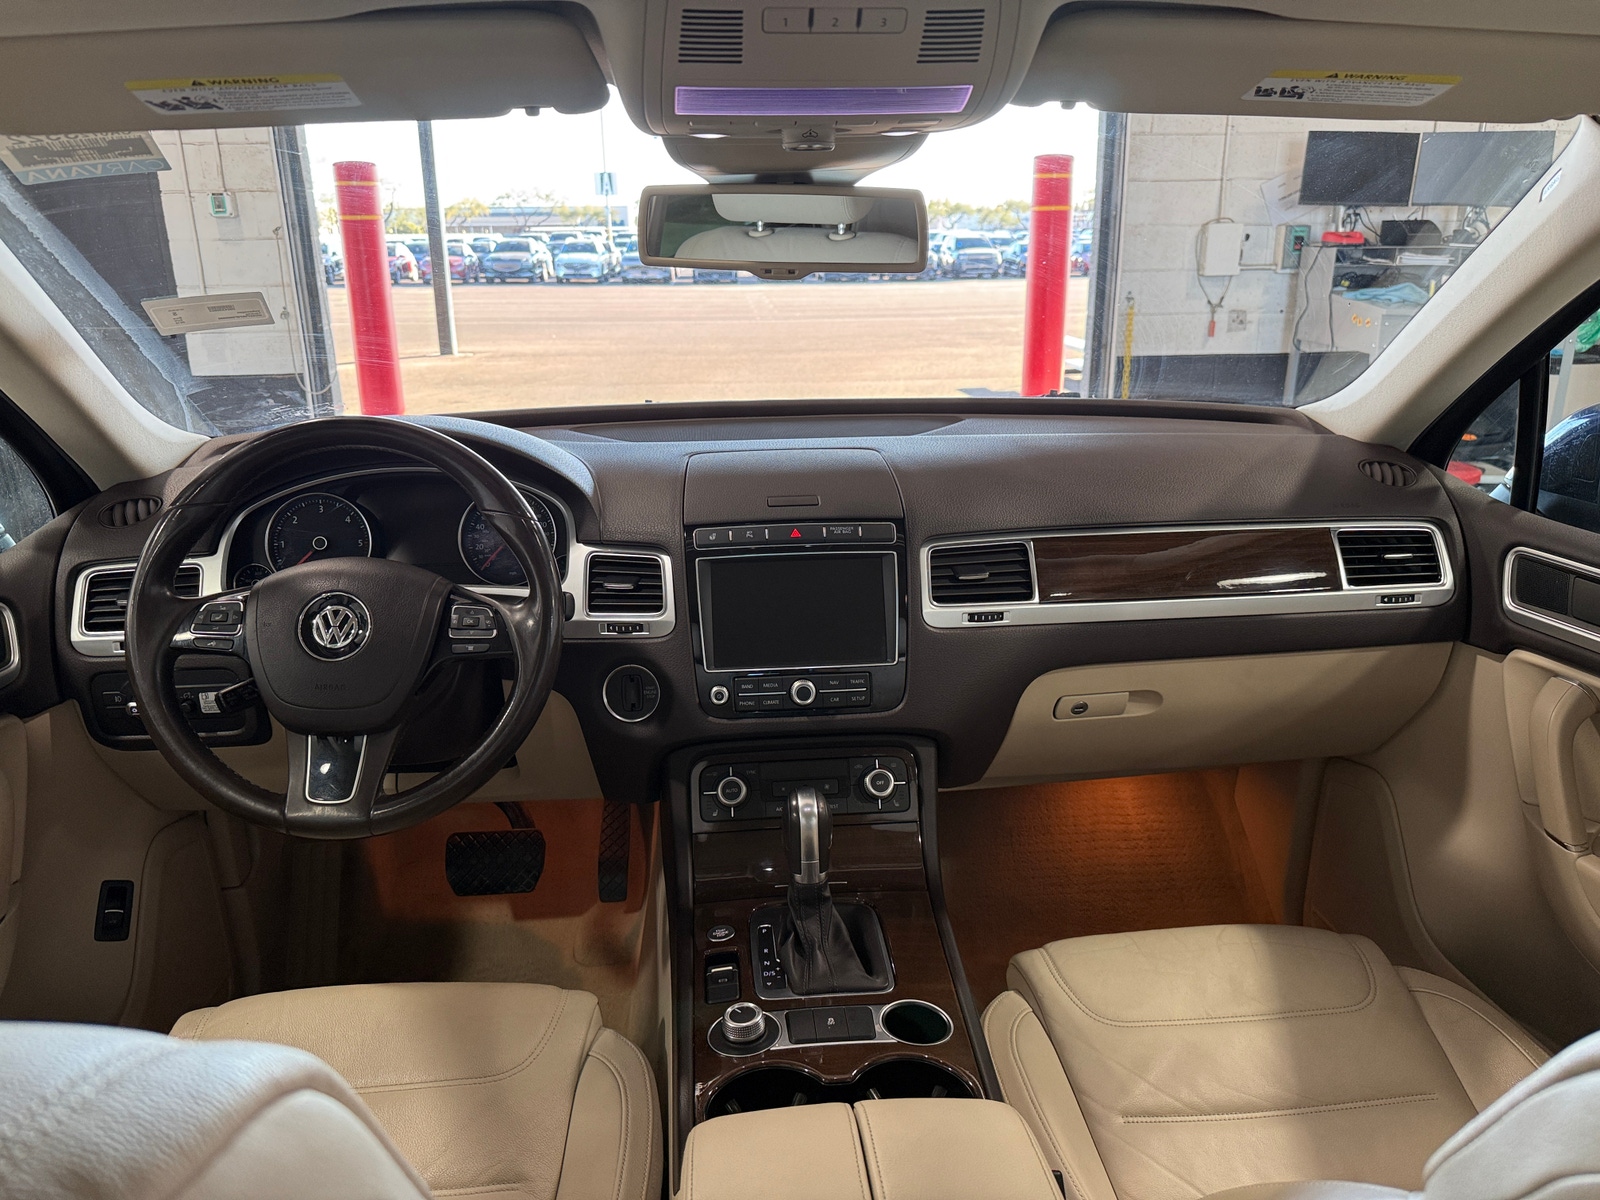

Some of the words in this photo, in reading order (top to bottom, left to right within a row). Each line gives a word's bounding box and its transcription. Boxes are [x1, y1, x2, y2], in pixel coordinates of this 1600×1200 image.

[783, 17, 788, 27] 1
[832, 17, 839, 27] 2
[880, 18, 887, 27] 3
[207, 77, 280, 86] WARNING
[1343, 73, 1407, 81] WARNING
[319, 505, 324, 513] 3
[292, 515, 298, 524] 2
[345, 515, 351, 523] 4
